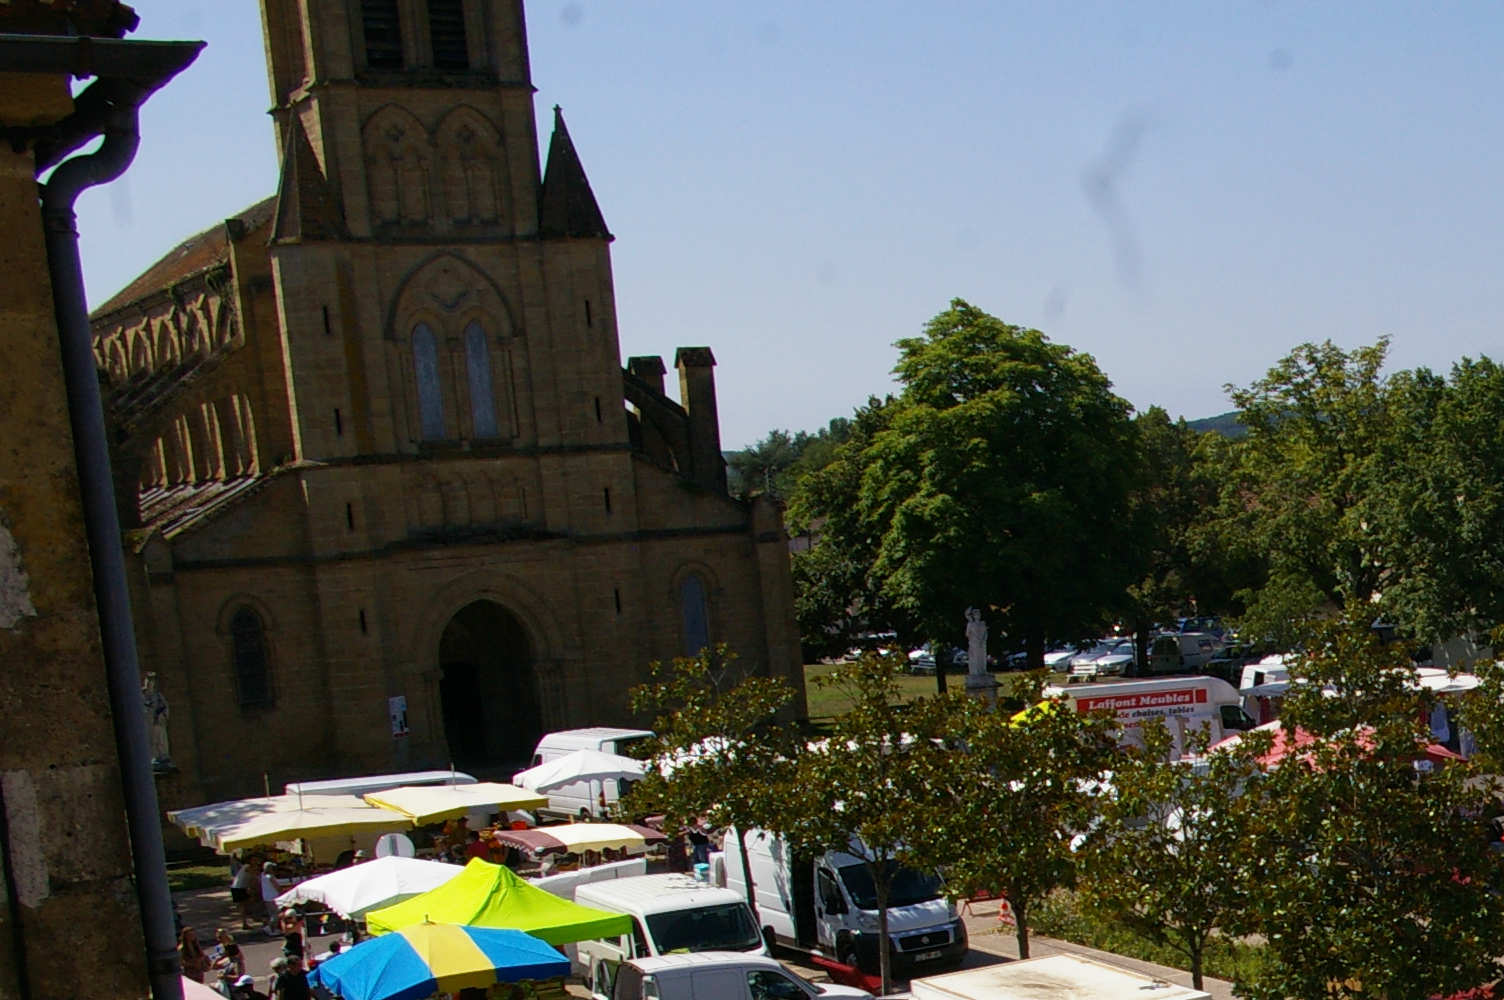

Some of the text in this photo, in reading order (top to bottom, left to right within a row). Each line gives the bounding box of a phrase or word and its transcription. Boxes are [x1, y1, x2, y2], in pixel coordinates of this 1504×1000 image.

[1088, 693, 1191, 711] Laffont Meubles
[1168, 705, 1195, 715] tables
